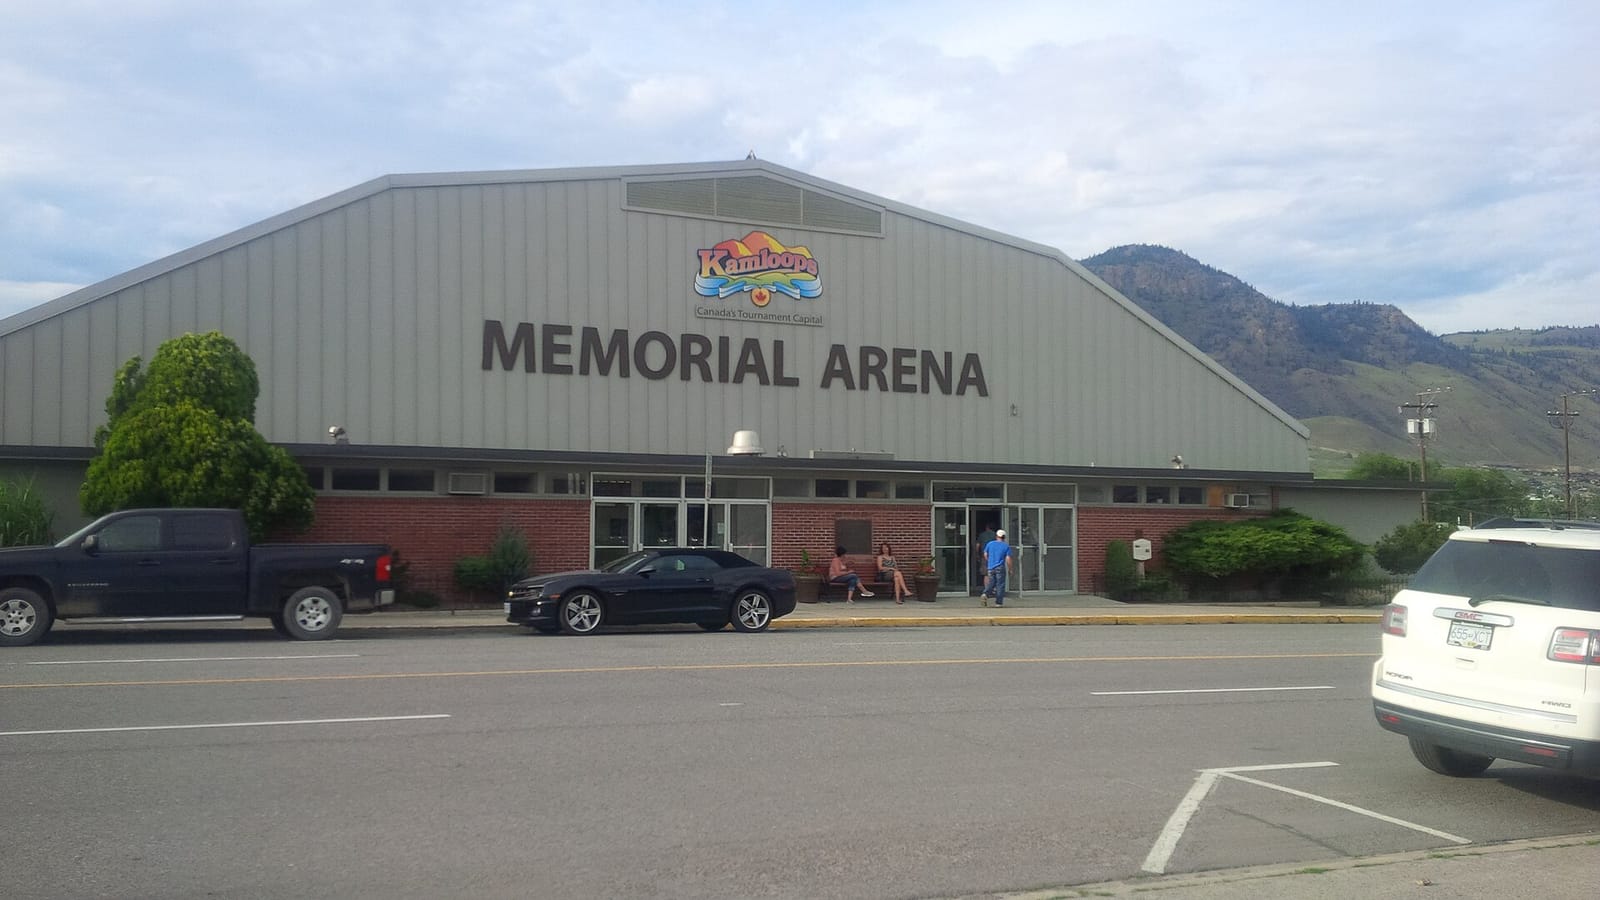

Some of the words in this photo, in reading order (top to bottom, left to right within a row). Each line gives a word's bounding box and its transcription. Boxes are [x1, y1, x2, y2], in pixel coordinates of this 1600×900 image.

[697, 248, 818, 277] Kamloops
[697, 306, 736, 318] Canada's
[738, 309, 790, 320] Tournament
[792, 313, 823, 325] Capital
[481, 319, 800, 386] MEMORIAL
[819, 343, 989, 397] ARENA
[1455, 611, 1483, 621] GMC
